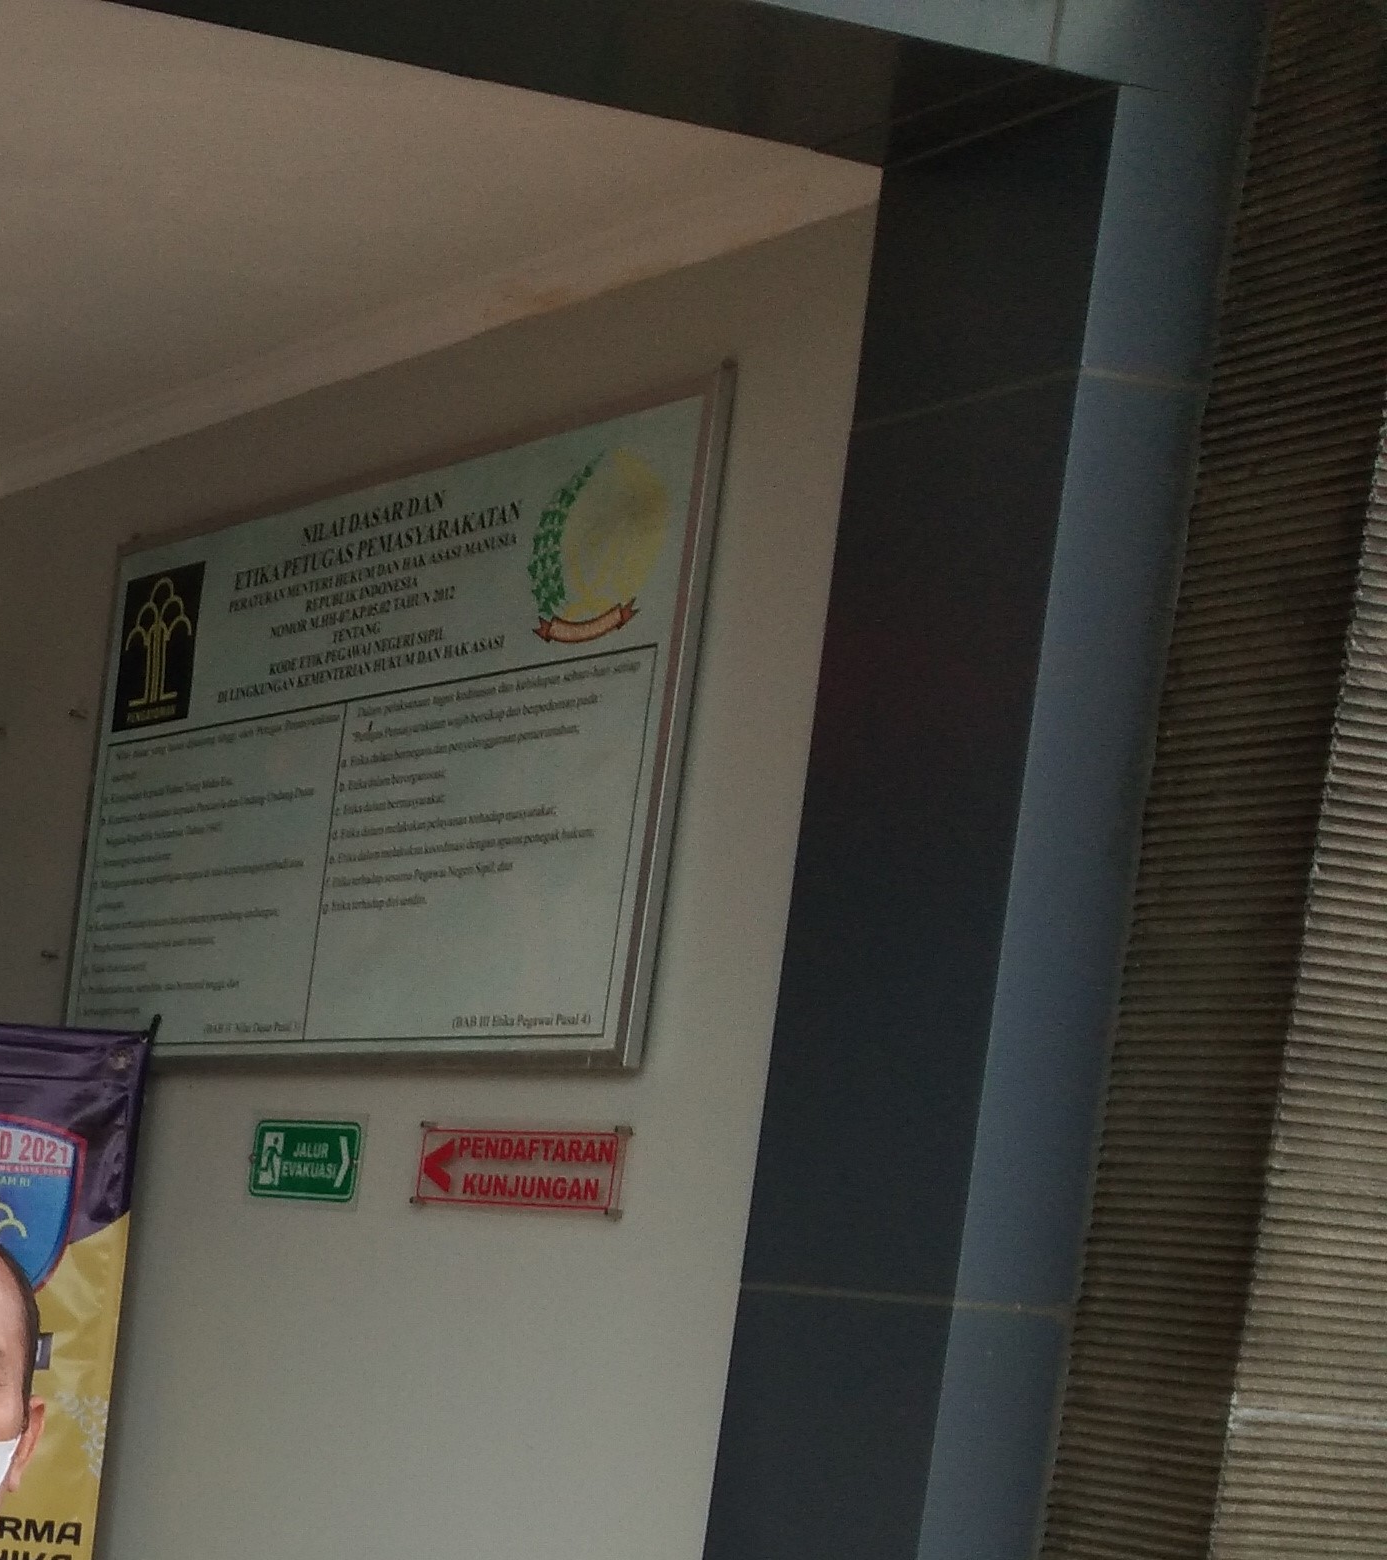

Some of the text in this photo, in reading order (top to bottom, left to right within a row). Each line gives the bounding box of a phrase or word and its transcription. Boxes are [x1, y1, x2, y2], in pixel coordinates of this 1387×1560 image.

[302, 490, 446, 545] NILAI DASAR DAN
[234, 499, 522, 591] ETIKA PETUGAS PEMASYARAKATAN
[19, 1134, 68, 1164] 2021
[293, 1142, 329, 1158] JALUR
[459, 1137, 614, 1163] PENDAFTARAN
[281, 1162, 337, 1179] EVAKUASI
[462, 1173, 599, 1201] KUNJUNGAN
